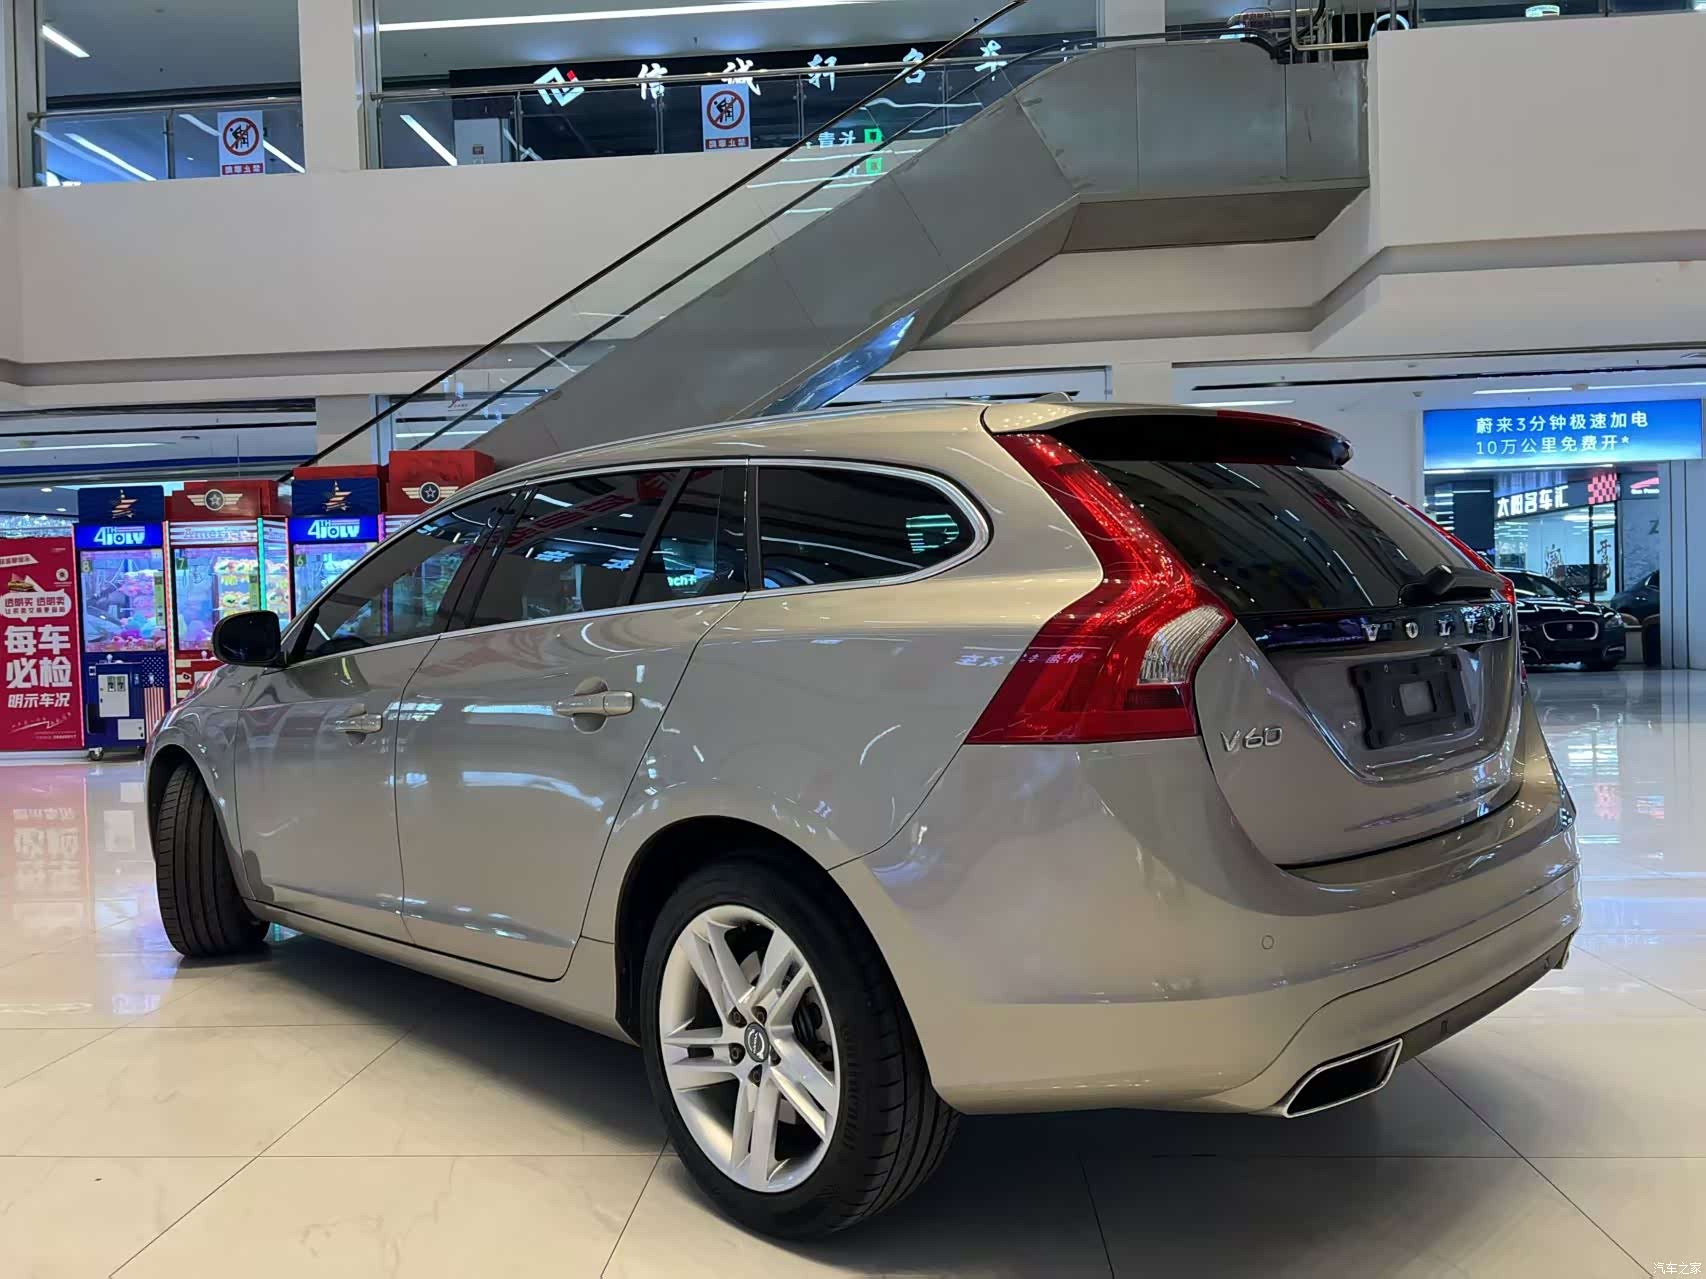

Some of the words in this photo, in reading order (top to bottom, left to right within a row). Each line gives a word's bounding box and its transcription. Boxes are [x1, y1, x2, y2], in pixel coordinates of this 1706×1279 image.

[1475, 411, 1648, 434] 蔚来3分钟极速加电
[4, 624, 71, 655] 每车
[1361, 614, 1496, 642] VOLVO
[6, 656, 72, 688] 必检
[8, 692, 71, 708] 明示车况
[1220, 727, 1283, 753] V60
